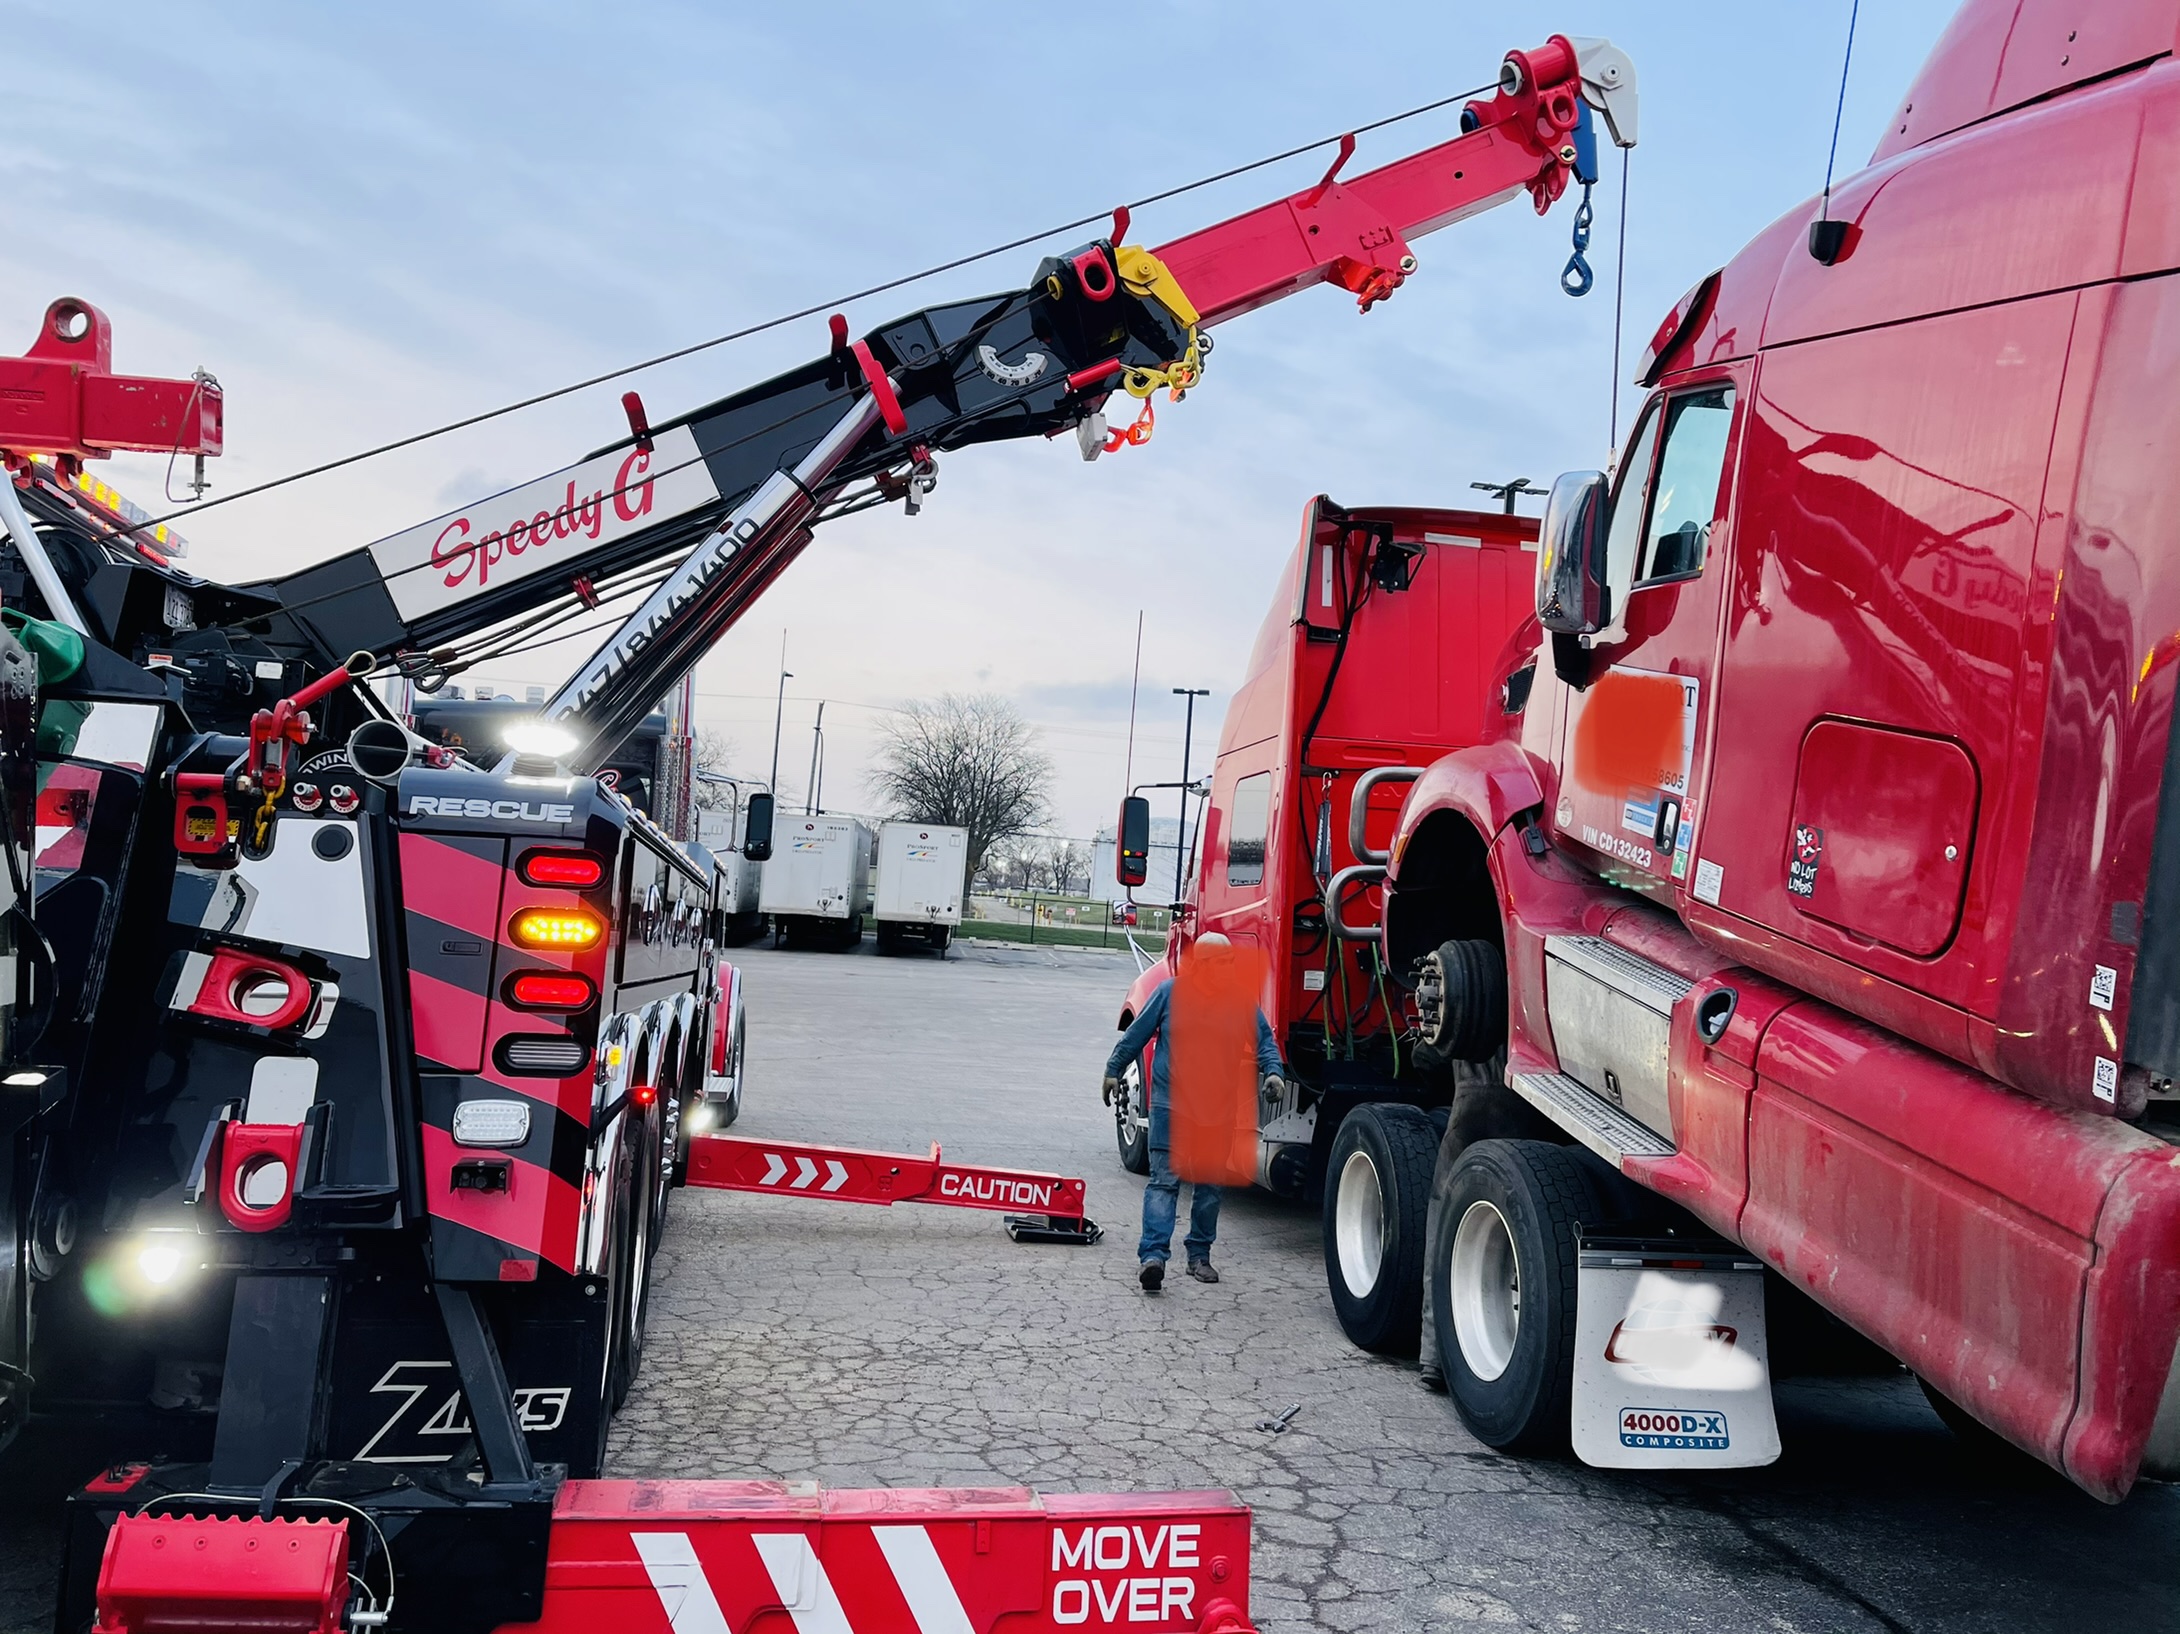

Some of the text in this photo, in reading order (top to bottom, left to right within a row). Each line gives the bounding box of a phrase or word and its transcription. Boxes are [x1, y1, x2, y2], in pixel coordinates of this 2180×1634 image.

[431, 448, 655, 587] Speedy G
[408, 795, 575, 823] RESCUE
[1582, 825, 1598, 846] VIN
[1599, 832, 1652, 868] CD132423
[1790, 860, 1818, 880] NO LOT
[940, 1173, 1052, 1207] CAUTION
[1623, 1413, 1722, 1434] 4000D-X
[1624, 1435, 1725, 1448] COMPOSITE
[1051, 1524, 1201, 1572] MOVE
[1052, 1576, 1196, 1625] OVER
